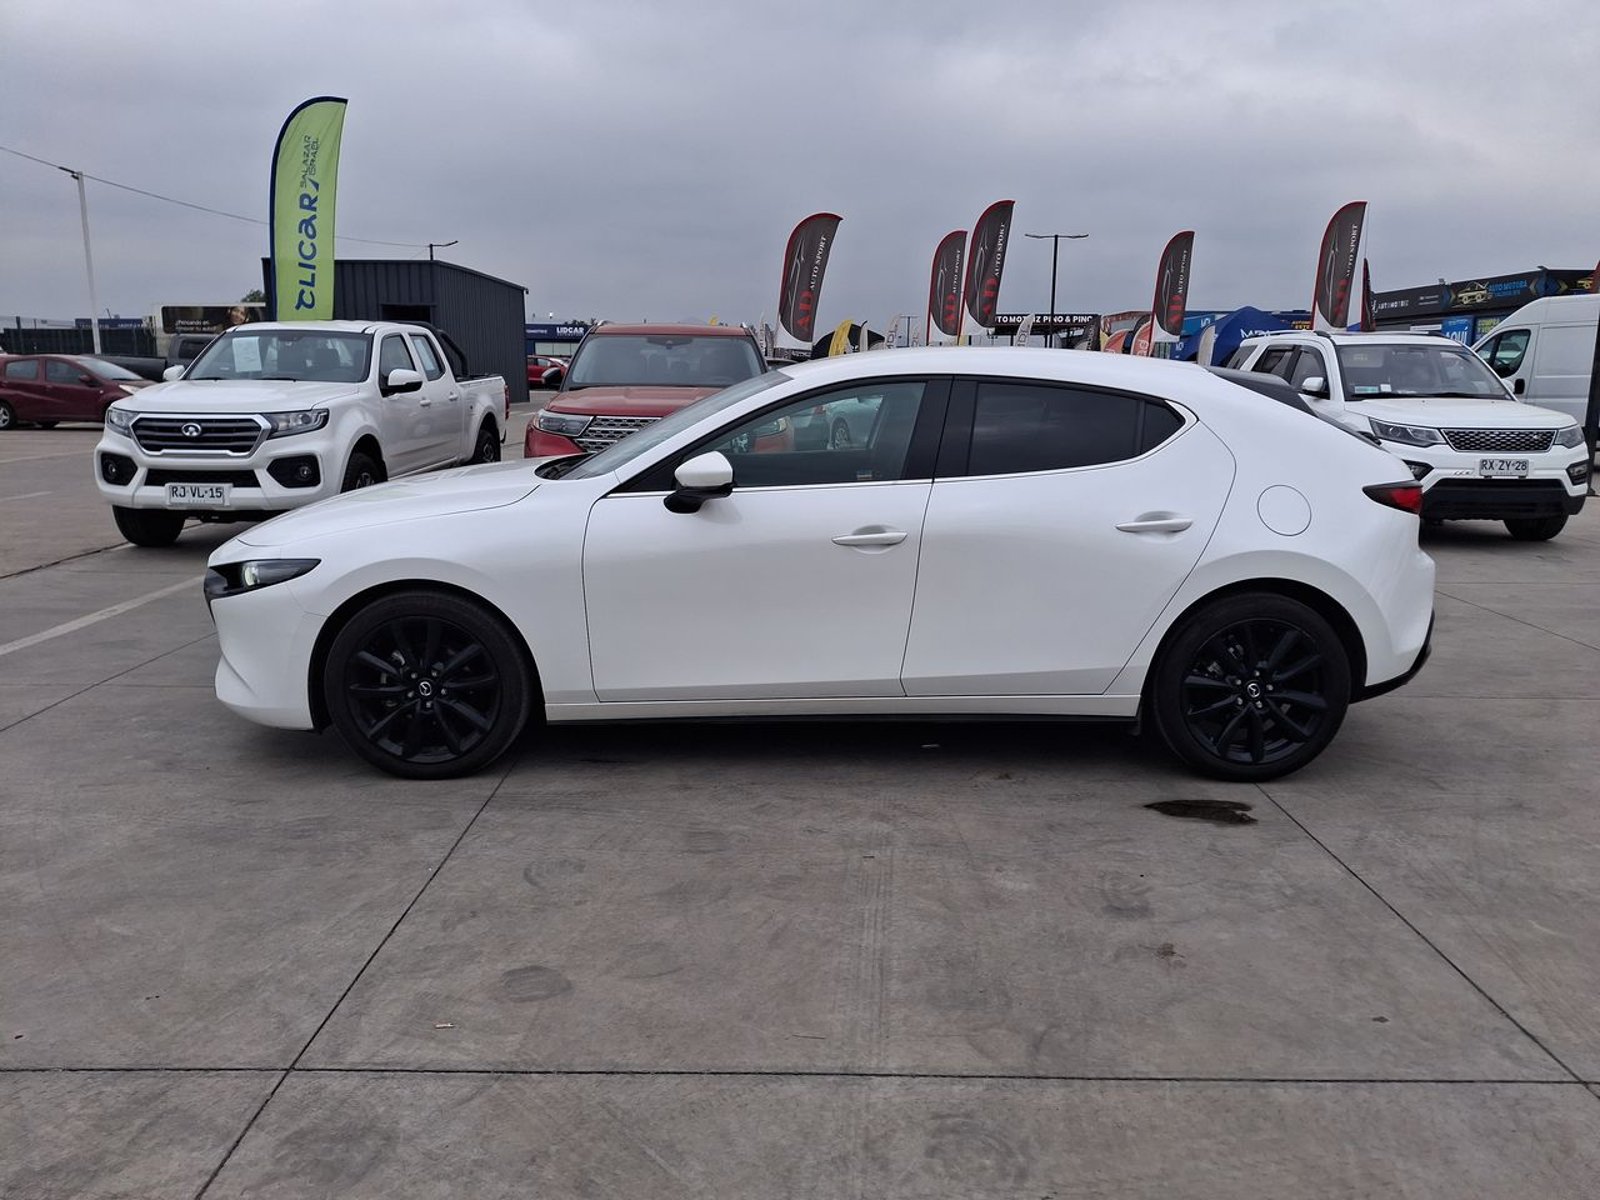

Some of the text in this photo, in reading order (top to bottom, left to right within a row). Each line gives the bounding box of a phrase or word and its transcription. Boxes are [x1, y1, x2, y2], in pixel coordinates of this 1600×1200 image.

[810, 235, 826, 290] AUTO SPORT
[994, 254, 1002, 277] AUTO
[556, 326, 584, 334] LIDCAR
